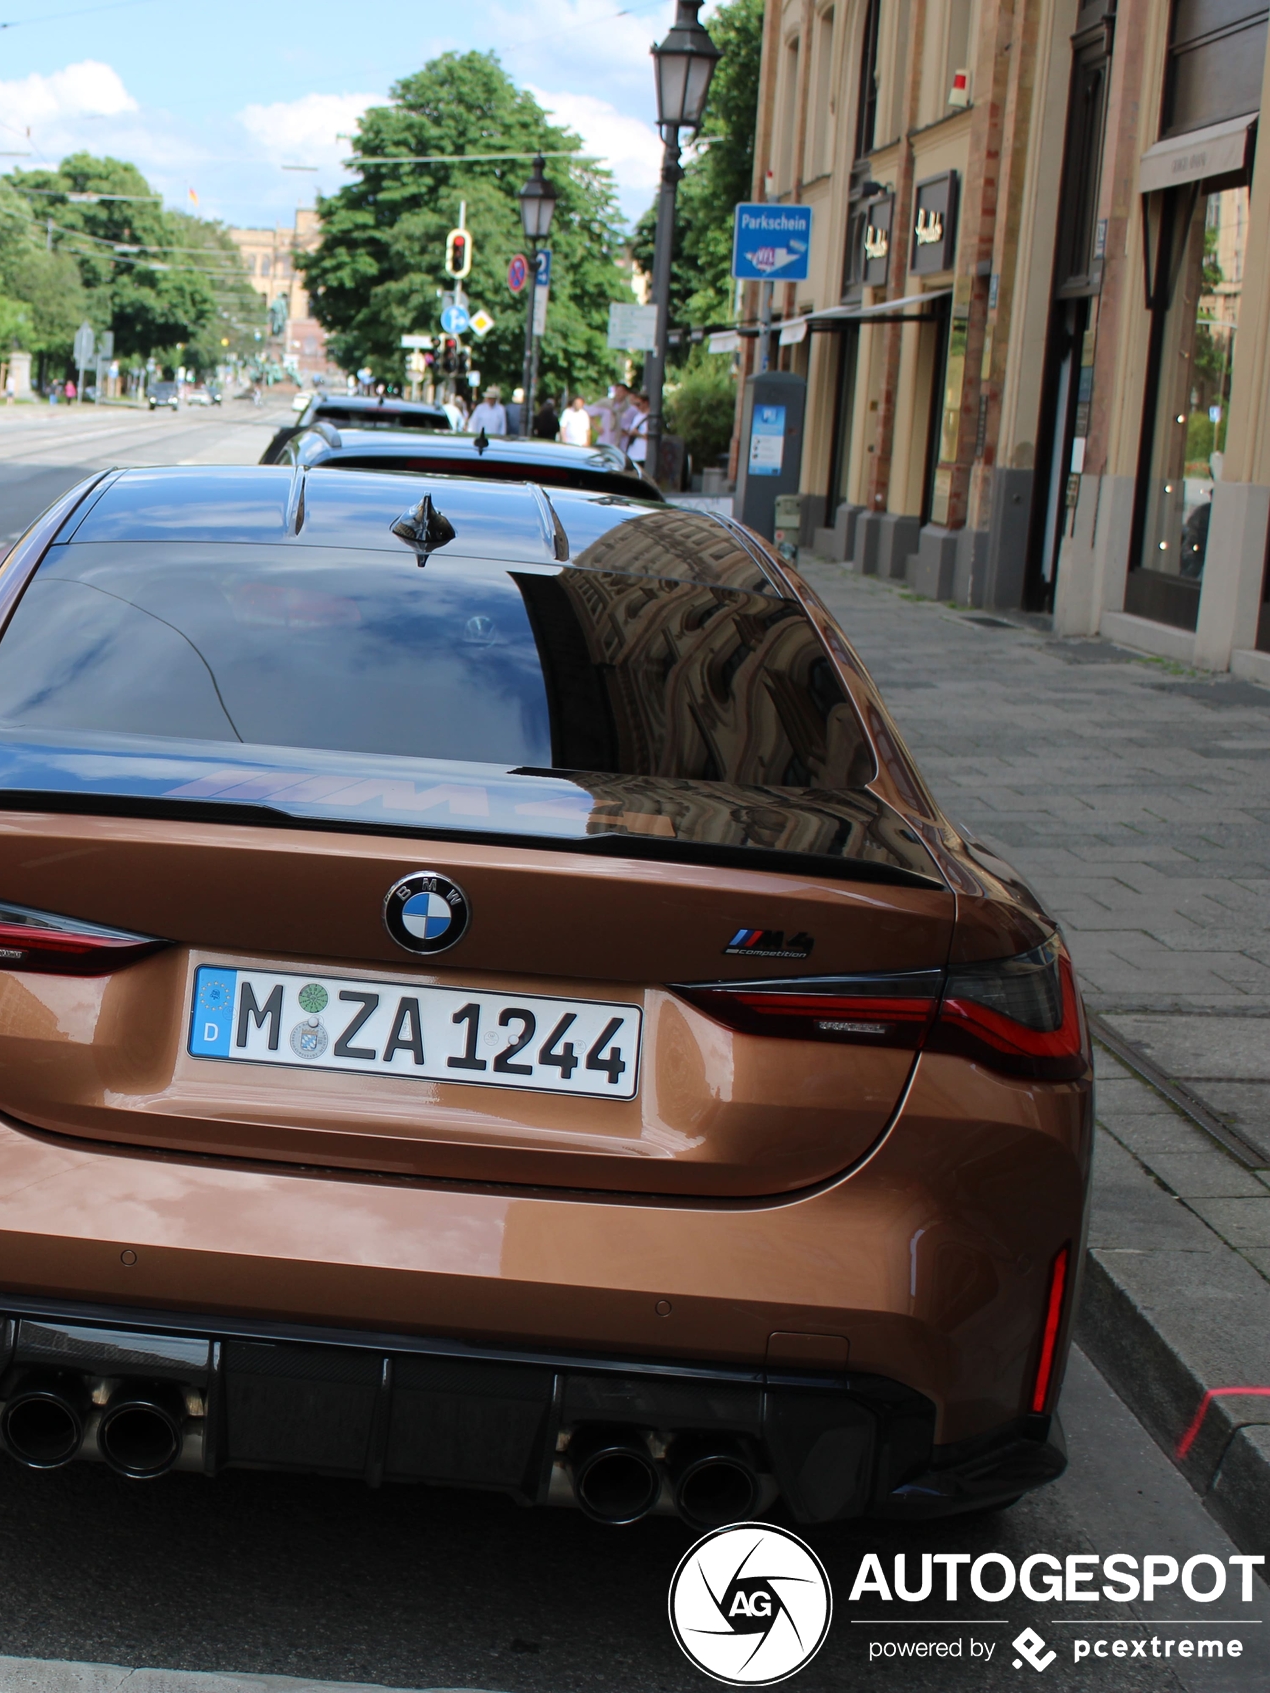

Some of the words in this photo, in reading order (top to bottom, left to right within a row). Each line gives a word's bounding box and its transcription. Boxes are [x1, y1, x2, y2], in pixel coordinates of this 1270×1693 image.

[741, 212, 807, 231] Parkschein
[395, 877, 463, 906] BMW
[738, 949, 807, 958] competition
[203, 1022, 219, 1042] D
[236, 981, 284, 1050] M
[334, 990, 424, 1065] ZA
[447, 1003, 626, 1084] 1244
